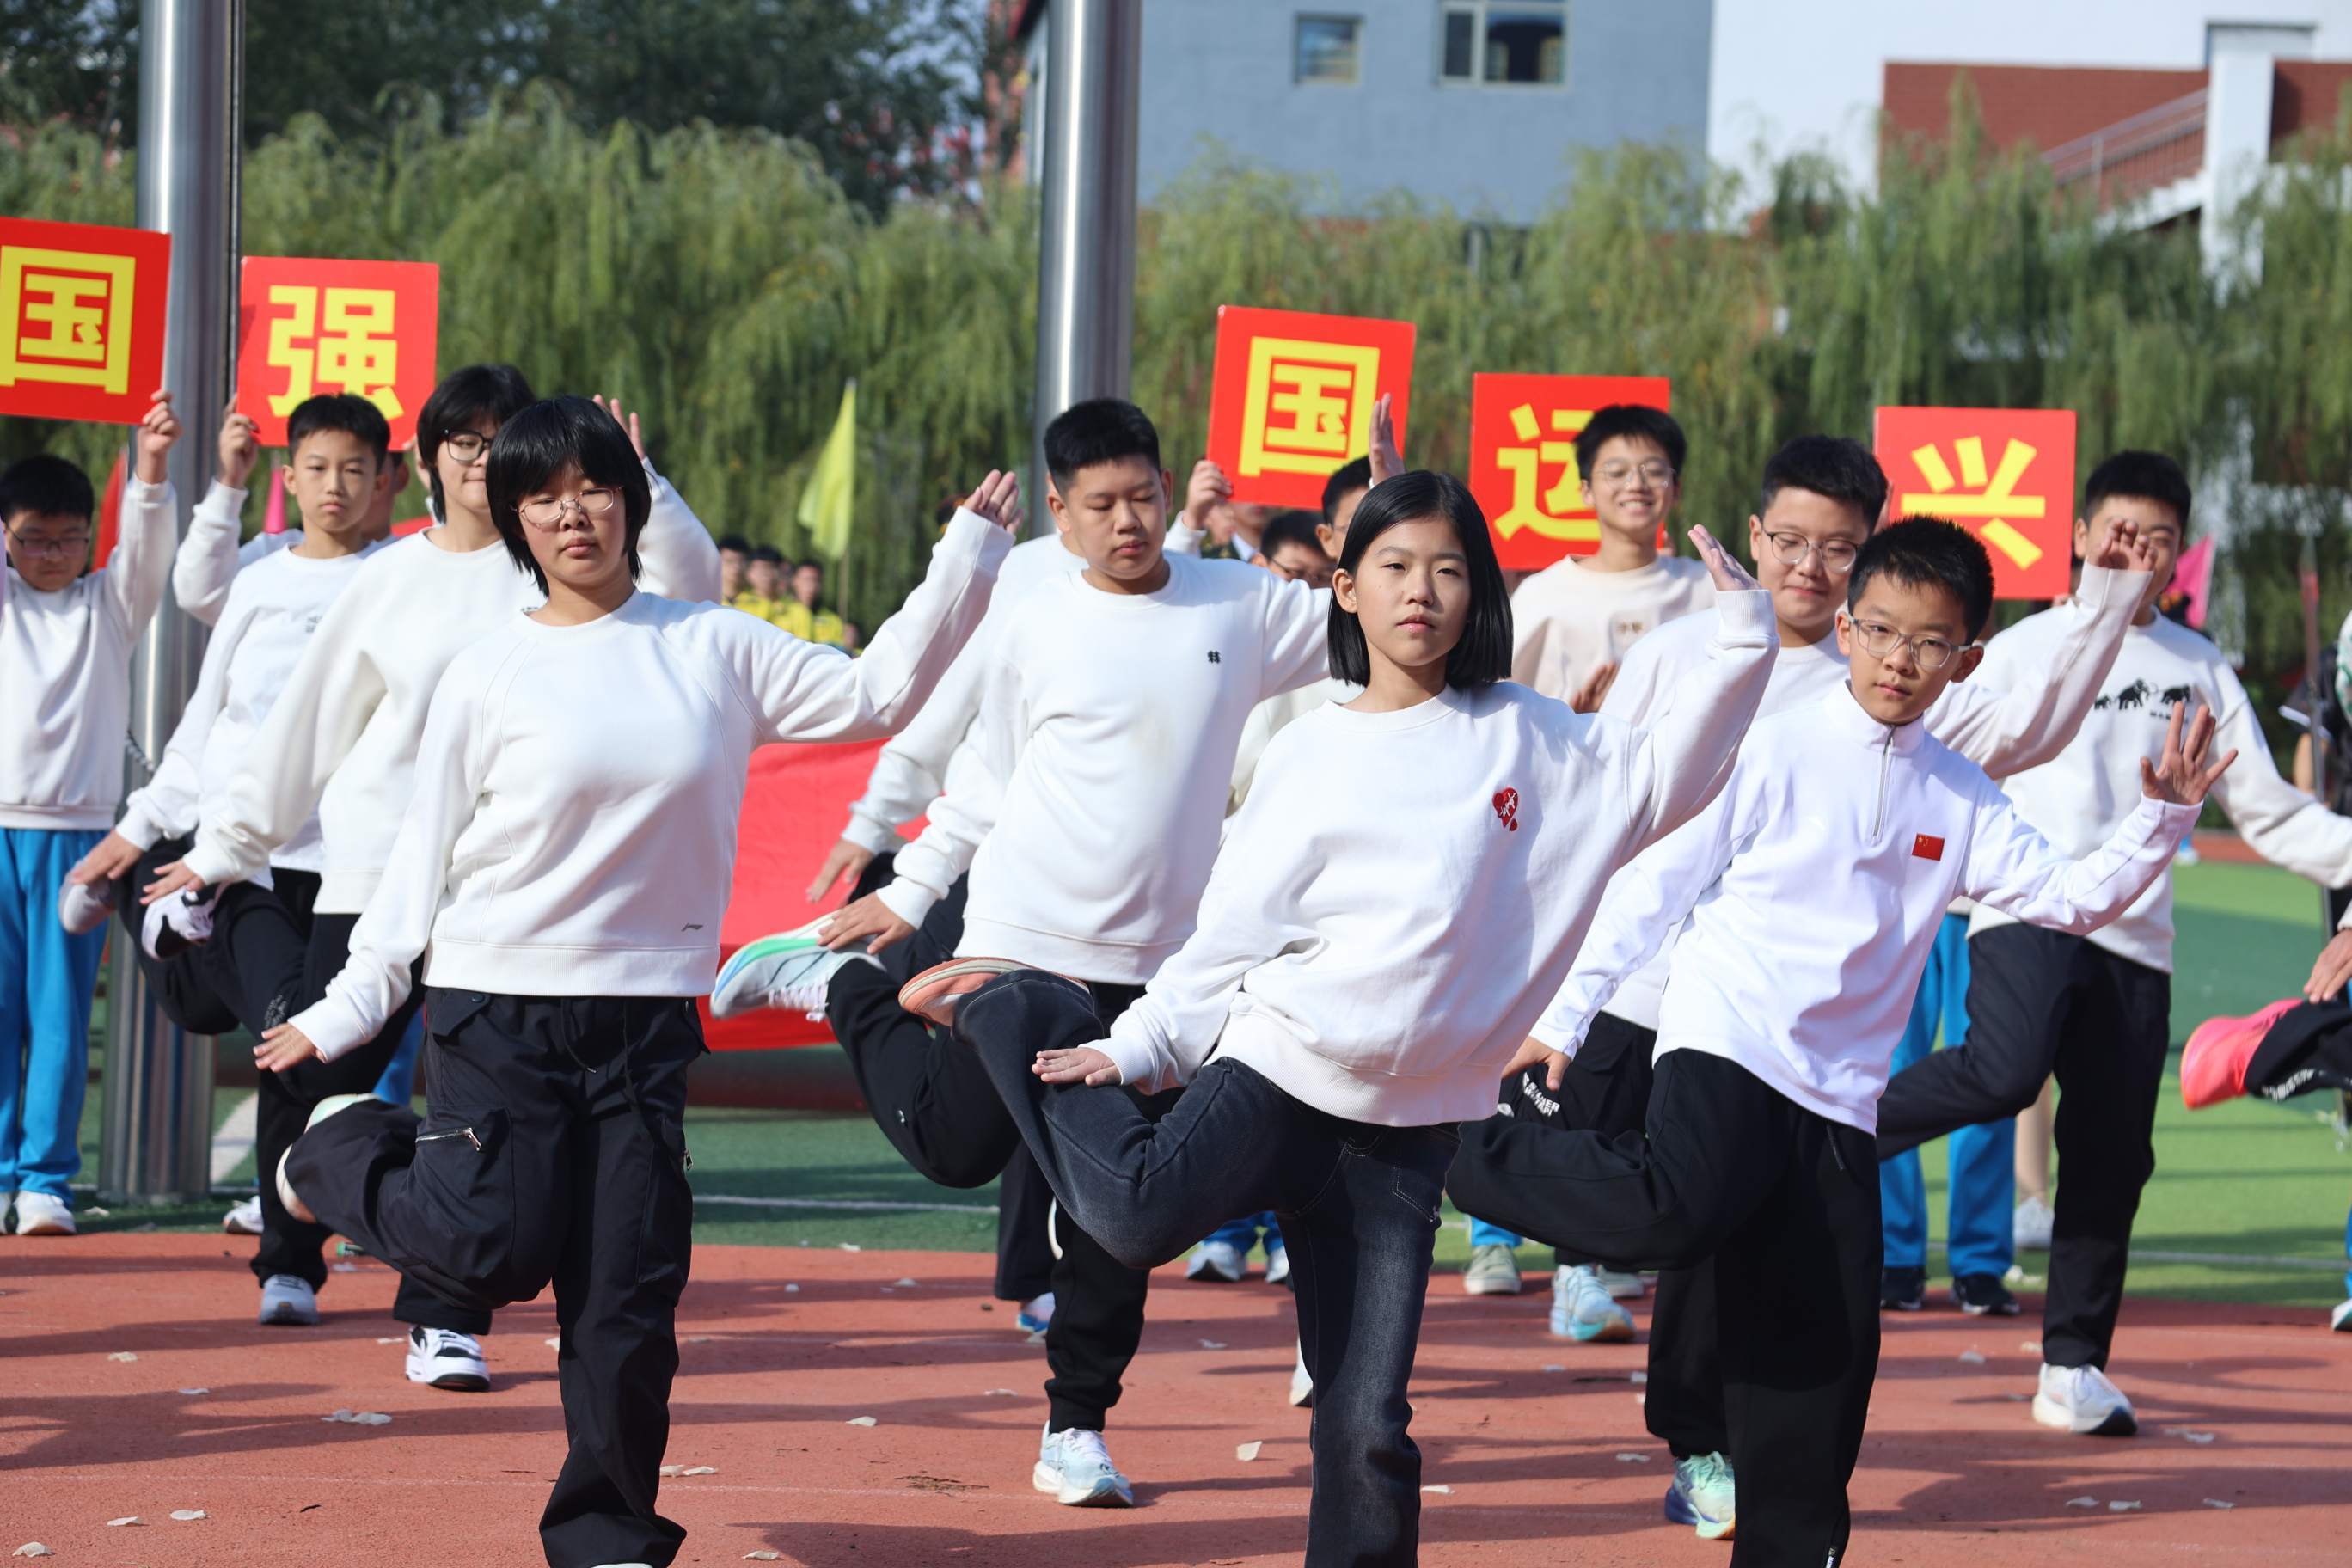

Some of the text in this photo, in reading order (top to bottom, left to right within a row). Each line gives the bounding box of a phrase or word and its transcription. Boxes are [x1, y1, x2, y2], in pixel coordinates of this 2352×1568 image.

[0, 244, 136, 395] 国
[267, 285, 404, 420] 强
[1238, 336, 1381, 477] 国
[1901, 436, 2045, 570] 兴
